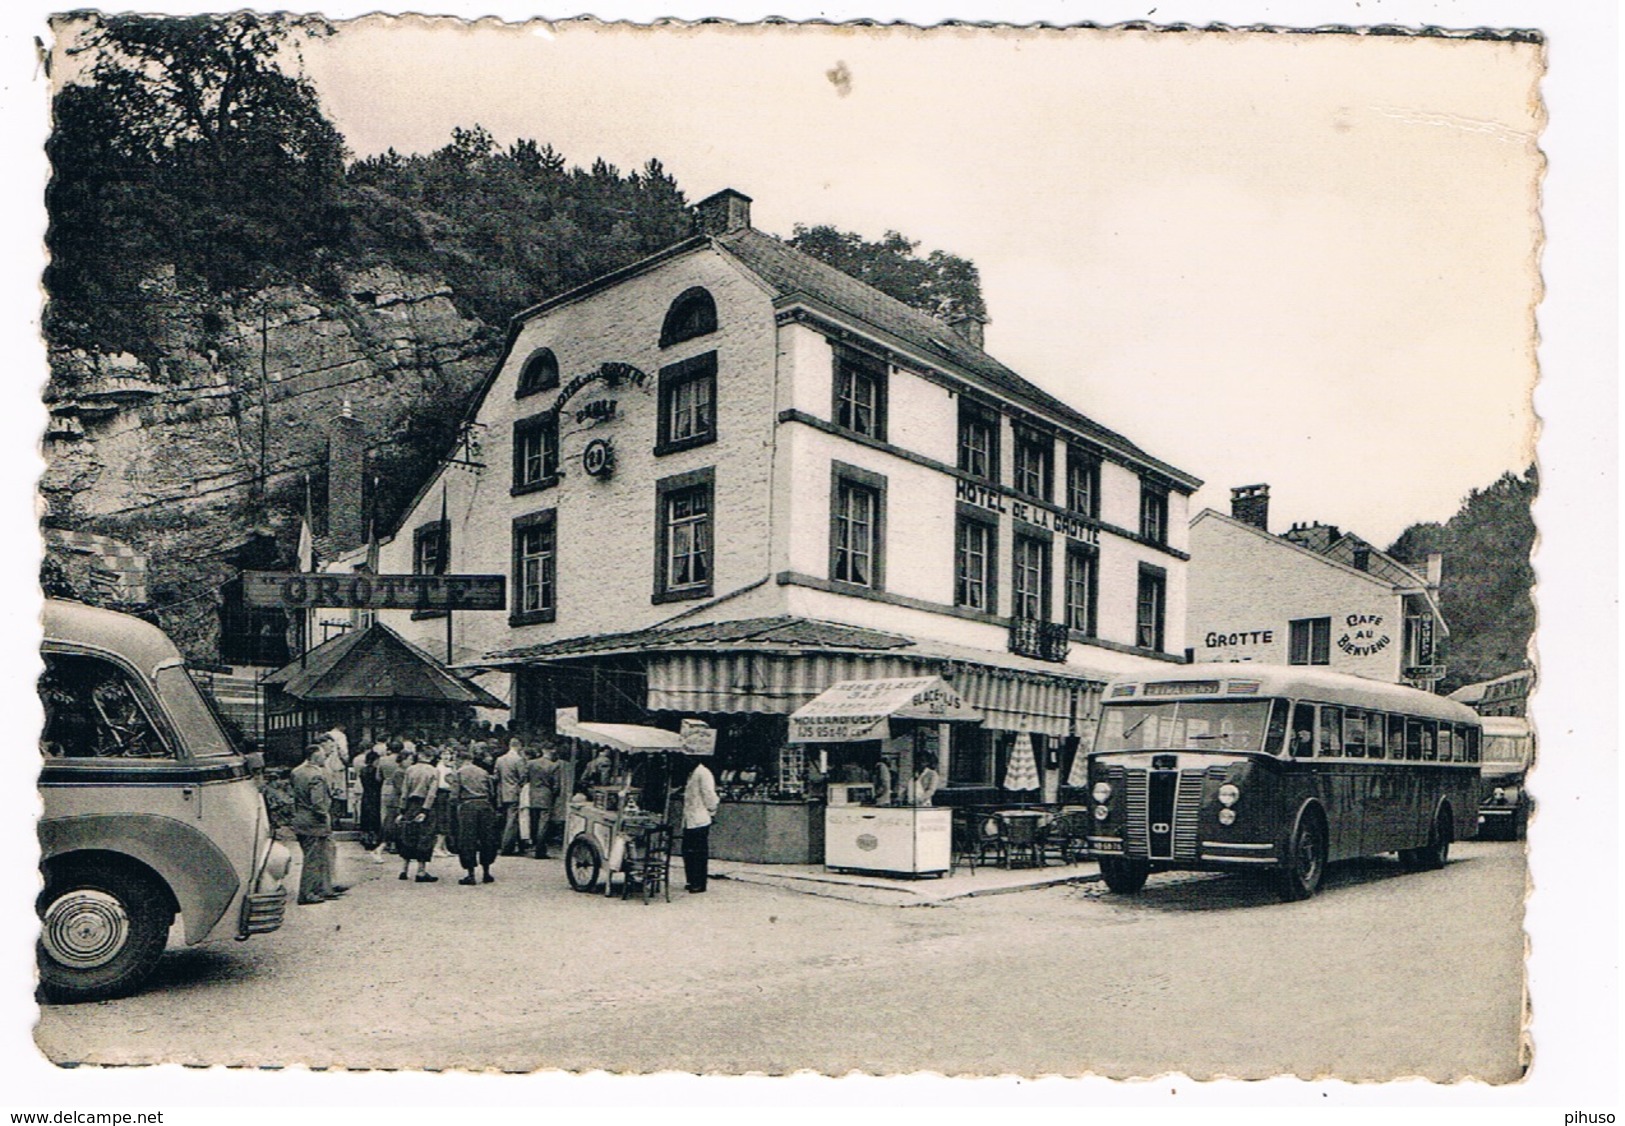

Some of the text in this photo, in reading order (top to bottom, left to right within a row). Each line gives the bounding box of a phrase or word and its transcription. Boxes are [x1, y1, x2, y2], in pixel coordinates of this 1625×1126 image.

[956, 478, 1100, 544] HOTEL DE LA GROTTE
[1205, 631, 1273, 648] GROTTE
[1337, 633, 1391, 656] BIENVENU
[1355, 630, 1374, 639] AU
